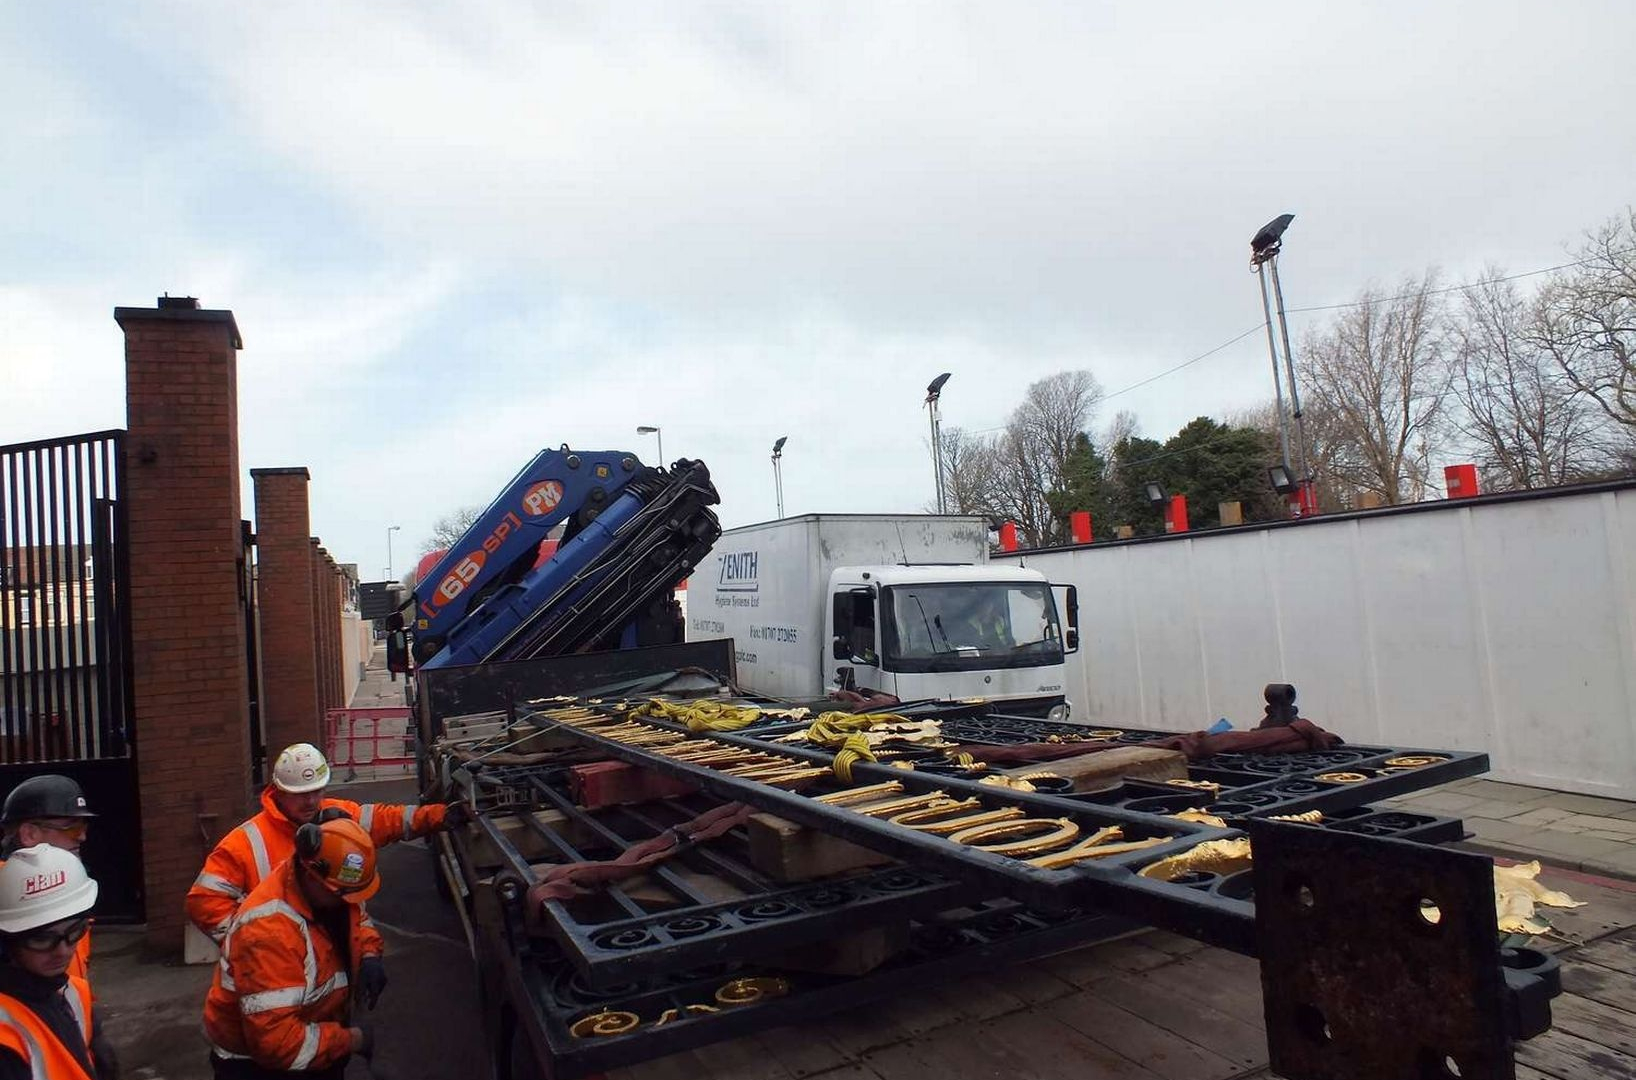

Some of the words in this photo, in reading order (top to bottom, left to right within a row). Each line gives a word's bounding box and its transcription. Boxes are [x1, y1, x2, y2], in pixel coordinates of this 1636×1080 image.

[525, 482, 562, 515] PM
[439, 557, 481, 600] 65
[717, 551, 758, 585] ZENITH
